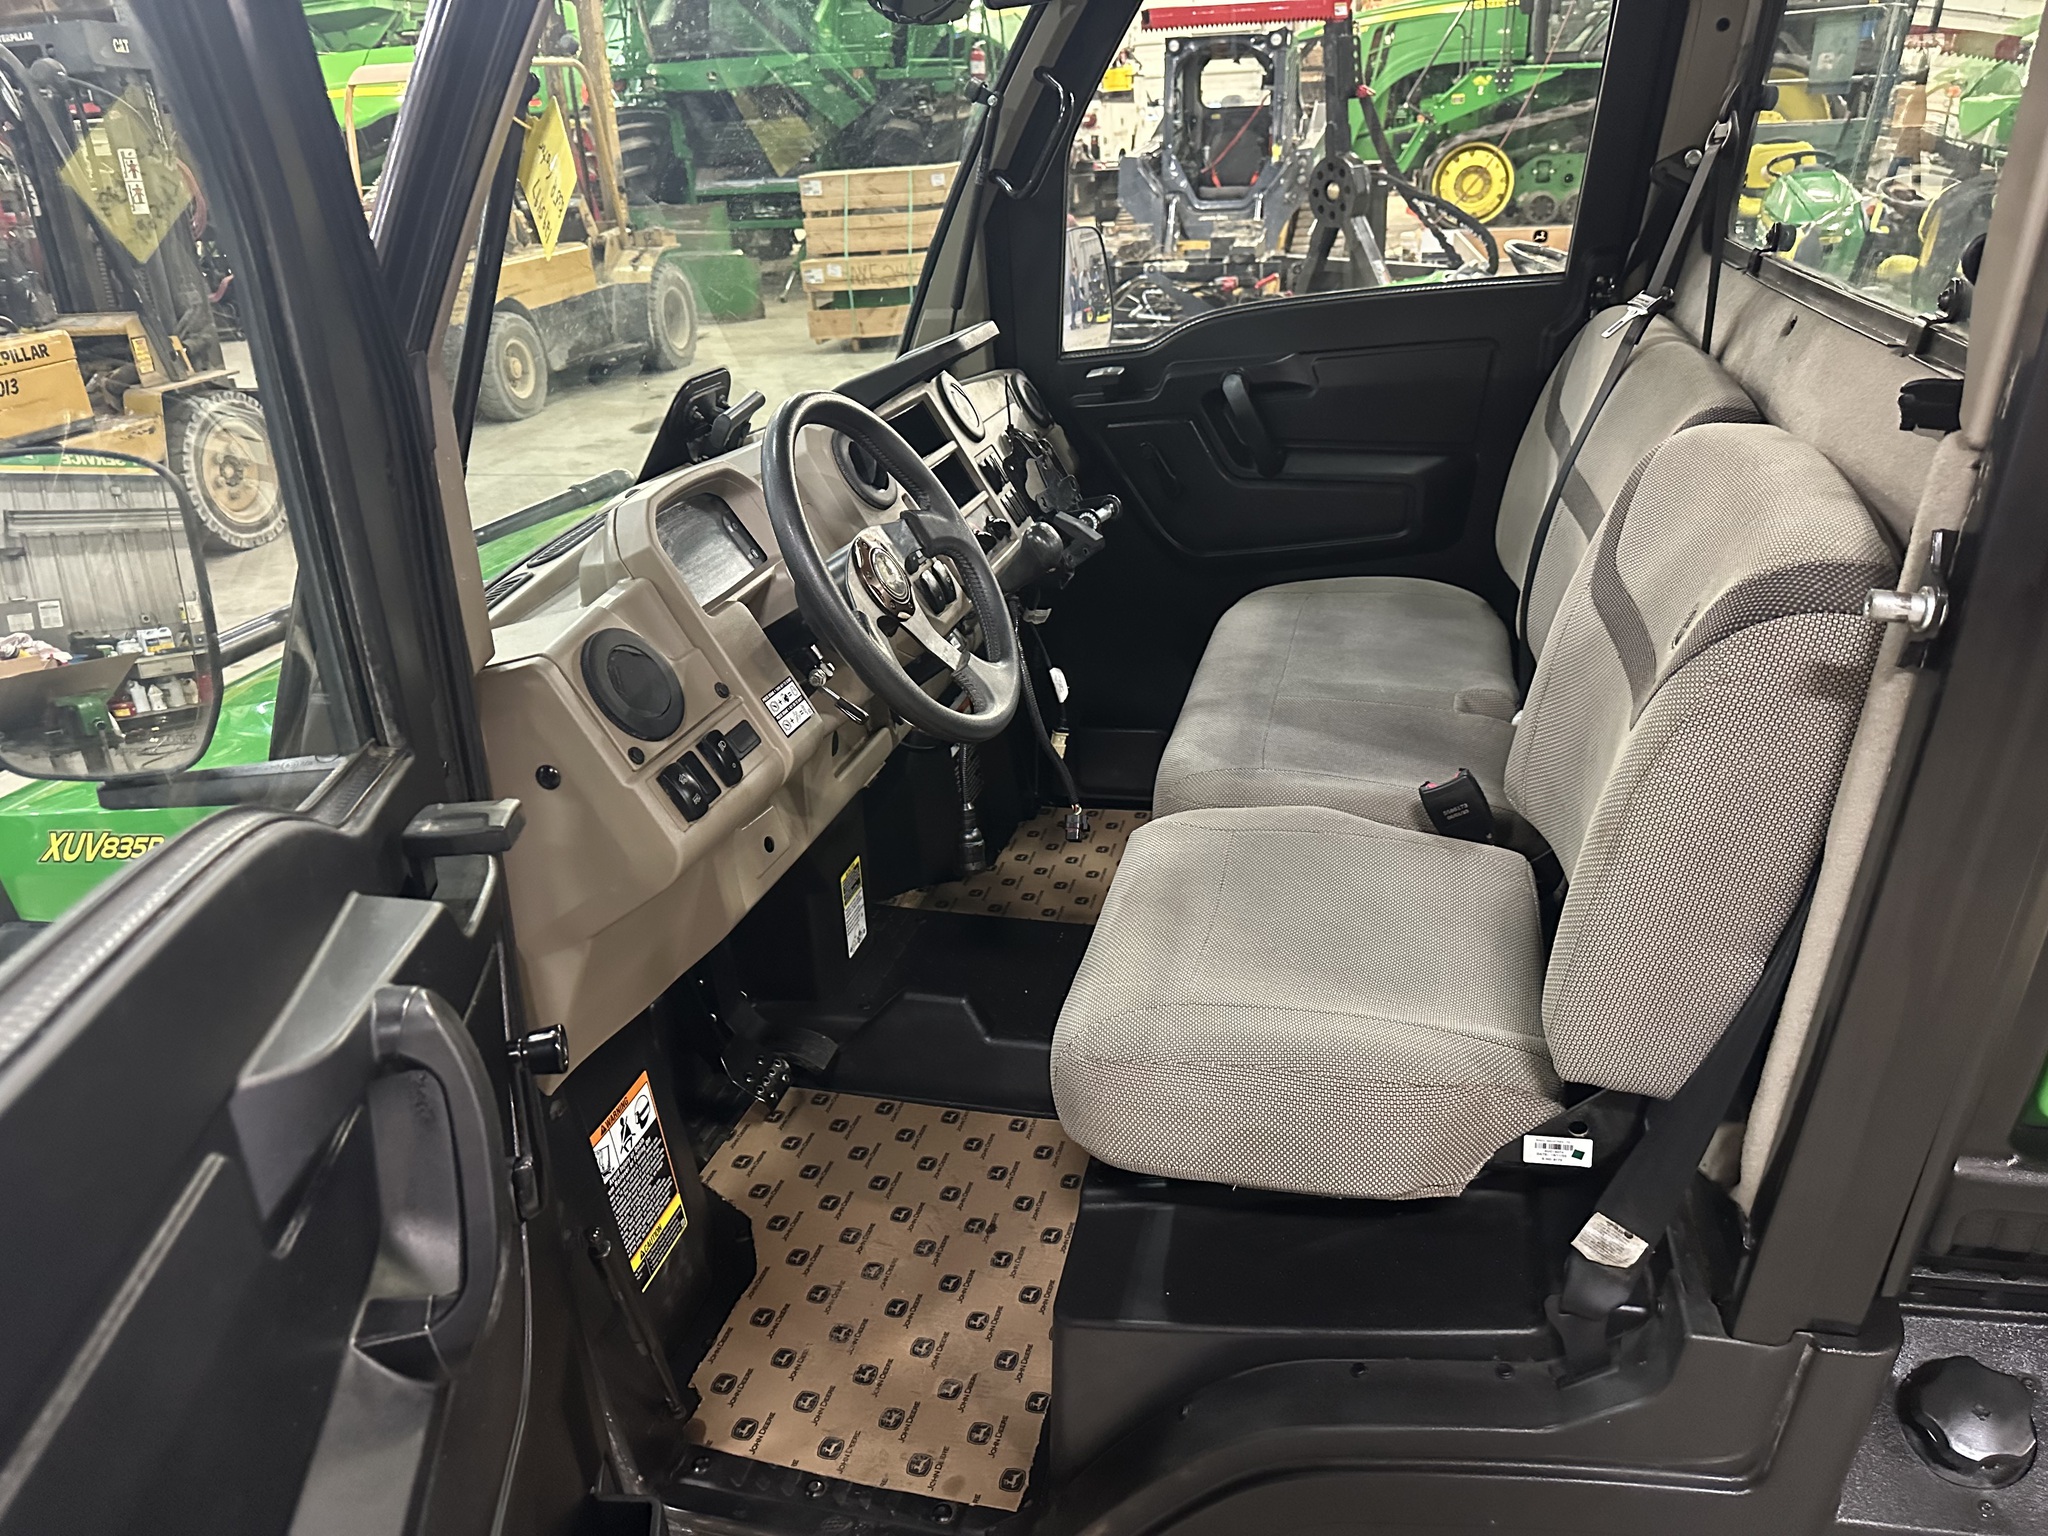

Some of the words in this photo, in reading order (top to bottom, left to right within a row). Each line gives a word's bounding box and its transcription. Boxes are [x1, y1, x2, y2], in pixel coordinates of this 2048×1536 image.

[112, 38, 130, 53] CAT
[0, 344, 50, 366] PILLAR
[605, 1097, 629, 1129] WARNING
[643, 1224, 663, 1253] CAUTION
[782, 1227, 793, 1241] JOHN
[789, 1211, 803, 1227] DEERE
[855, 1240, 866, 1254] JOHN
[862, 1223, 875, 1239] DEERE
[802, 1262, 813, 1276] JOHN
[809, 1244, 823, 1261] DEERE
[931, 1252, 941, 1266] JOHN
[936, 1234, 949, 1251] DEERE
[1009, 1264, 1019, 1278] JOHN
[1014, 1246, 1026, 1263] DEERE
[747, 1284, 758, 1299] JOHN
[754, 1266, 770, 1284] DEERE
[957, 1288, 967, 1303] JOHN
[962, 1269, 975, 1287] DEERE
[1043, 1279, 1055, 1298] DEERE
[767, 1323, 779, 1339] JOHN
[774, 1303, 790, 1322] DEERE
[824, 1299, 835, 1314] JOHN
[903, 1313, 914, 1328] JOHN
[909, 1293, 923, 1312] DEERE
[1039, 1299, 1048, 1314] JOHN
[853, 1318, 868, 1337] DEERE
[985, 1325, 995, 1342] JOHN
[990, 1305, 1003, 1325] DEERE
[708, 1347, 721, 1364] JOHN
[716, 1327, 733, 1346] DEERE
[929, 1352, 940, 1369] JOHN
[935, 1331, 949, 1352] DEERE
[788, 1364, 801, 1381] JOHN
[871, 1380, 883, 1398] JOHN
[878, 1358, 893, 1379] DEERE
[1015, 1365, 1025, 1382] JOHN
[1020, 1344, 1033, 1364] DEERE
[728, 1390, 741, 1407] JOHN
[736, 1368, 753, 1389] DEERE
[958, 1394, 969, 1413] JOHN
[812, 1407, 824, 1426] JOHN
[819, 1385, 835, 1406] DEERE
[749, 1435, 763, 1454] JOHN
[758, 1412, 775, 1434] DEERE
[898, 1424, 910, 1443] JOHN
[905, 1401, 920, 1423] DEERE
[994, 1415, 1008, 1438] DEERE
[837, 1454, 849, 1474] JOHN
[844, 1430, 861, 1453] DEERE
[989, 1439, 1000, 1458] JOHN
